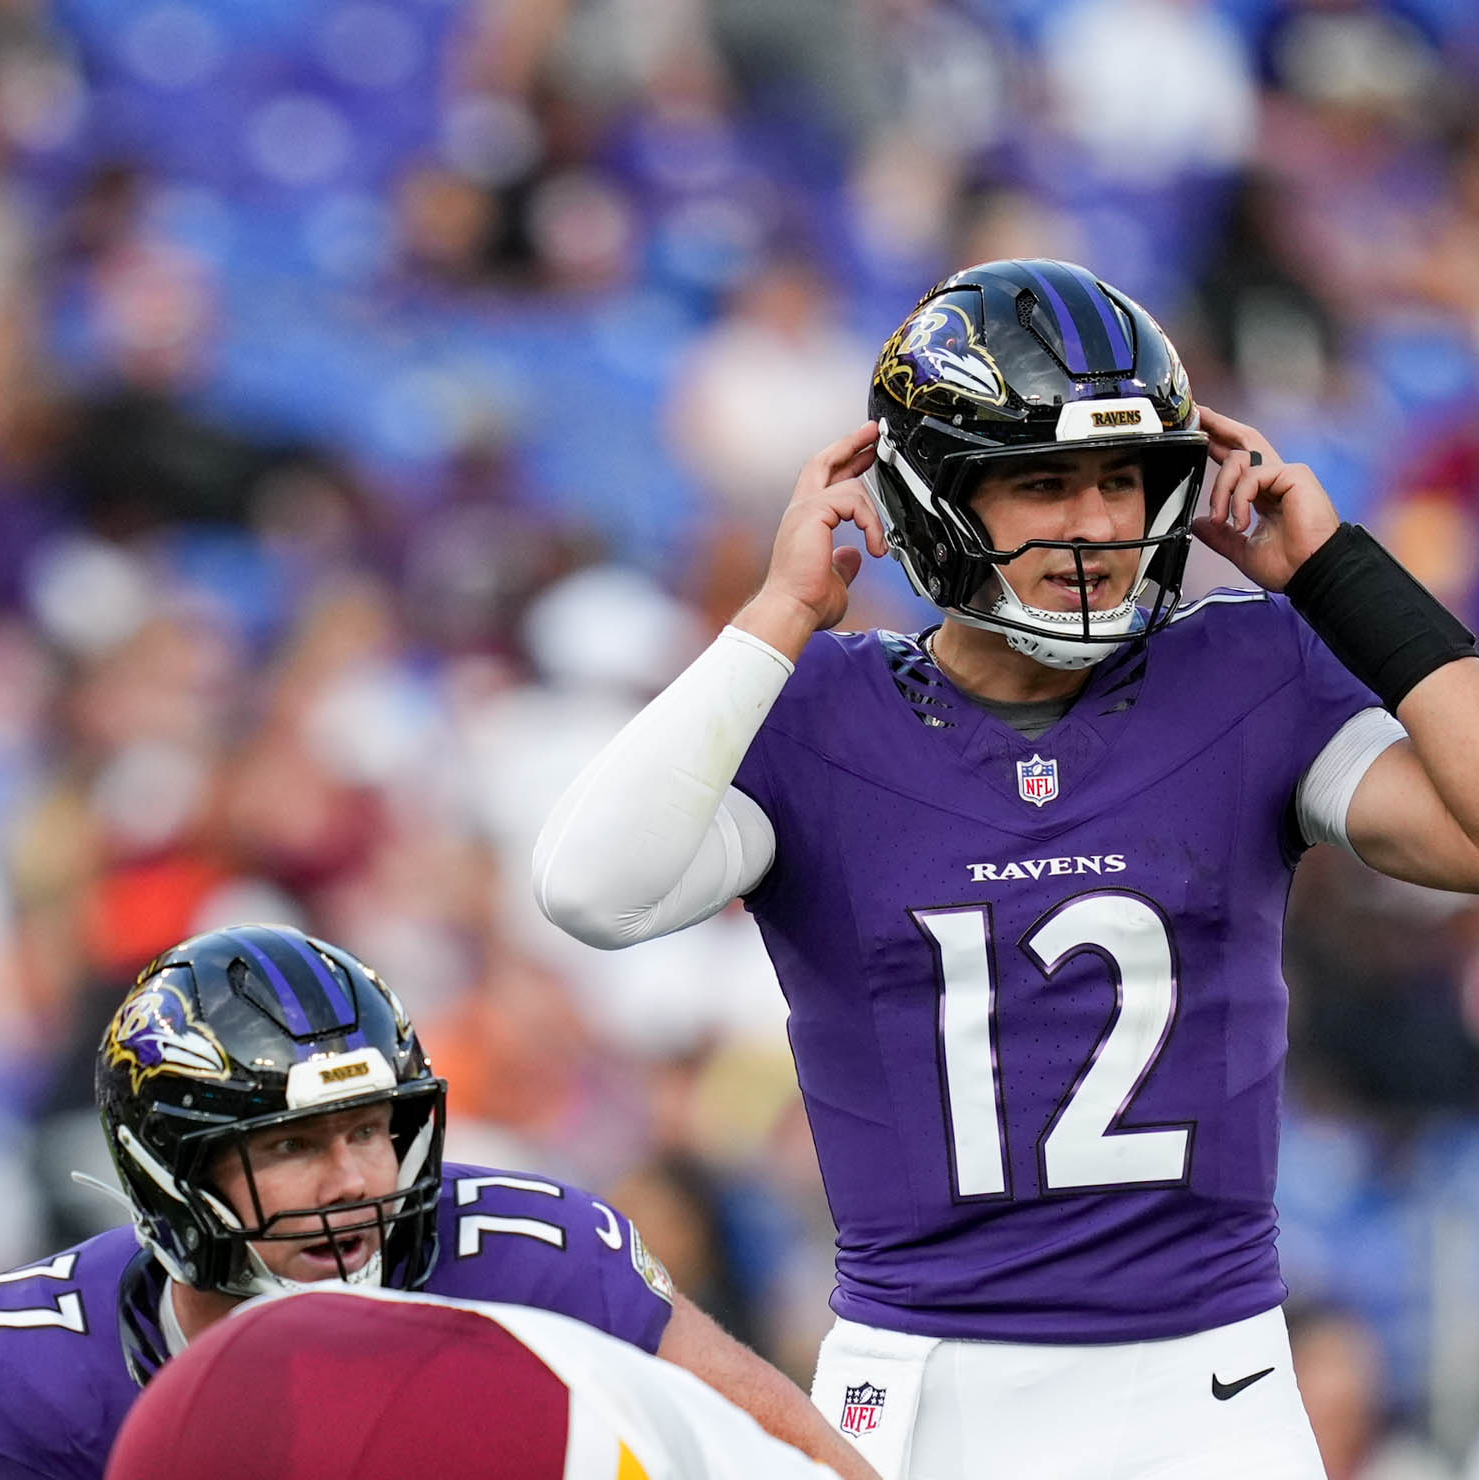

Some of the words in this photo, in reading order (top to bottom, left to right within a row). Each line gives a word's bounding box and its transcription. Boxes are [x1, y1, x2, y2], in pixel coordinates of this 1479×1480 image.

[1090, 409, 1142, 428] RAVENS
[1024, 777, 1053, 798] NFL
[965, 853, 1128, 883] RAVENS
[908, 887, 1196, 1201] 12
[455, 1174, 566, 1259] 77
[842, 1405, 878, 1433] NFL
